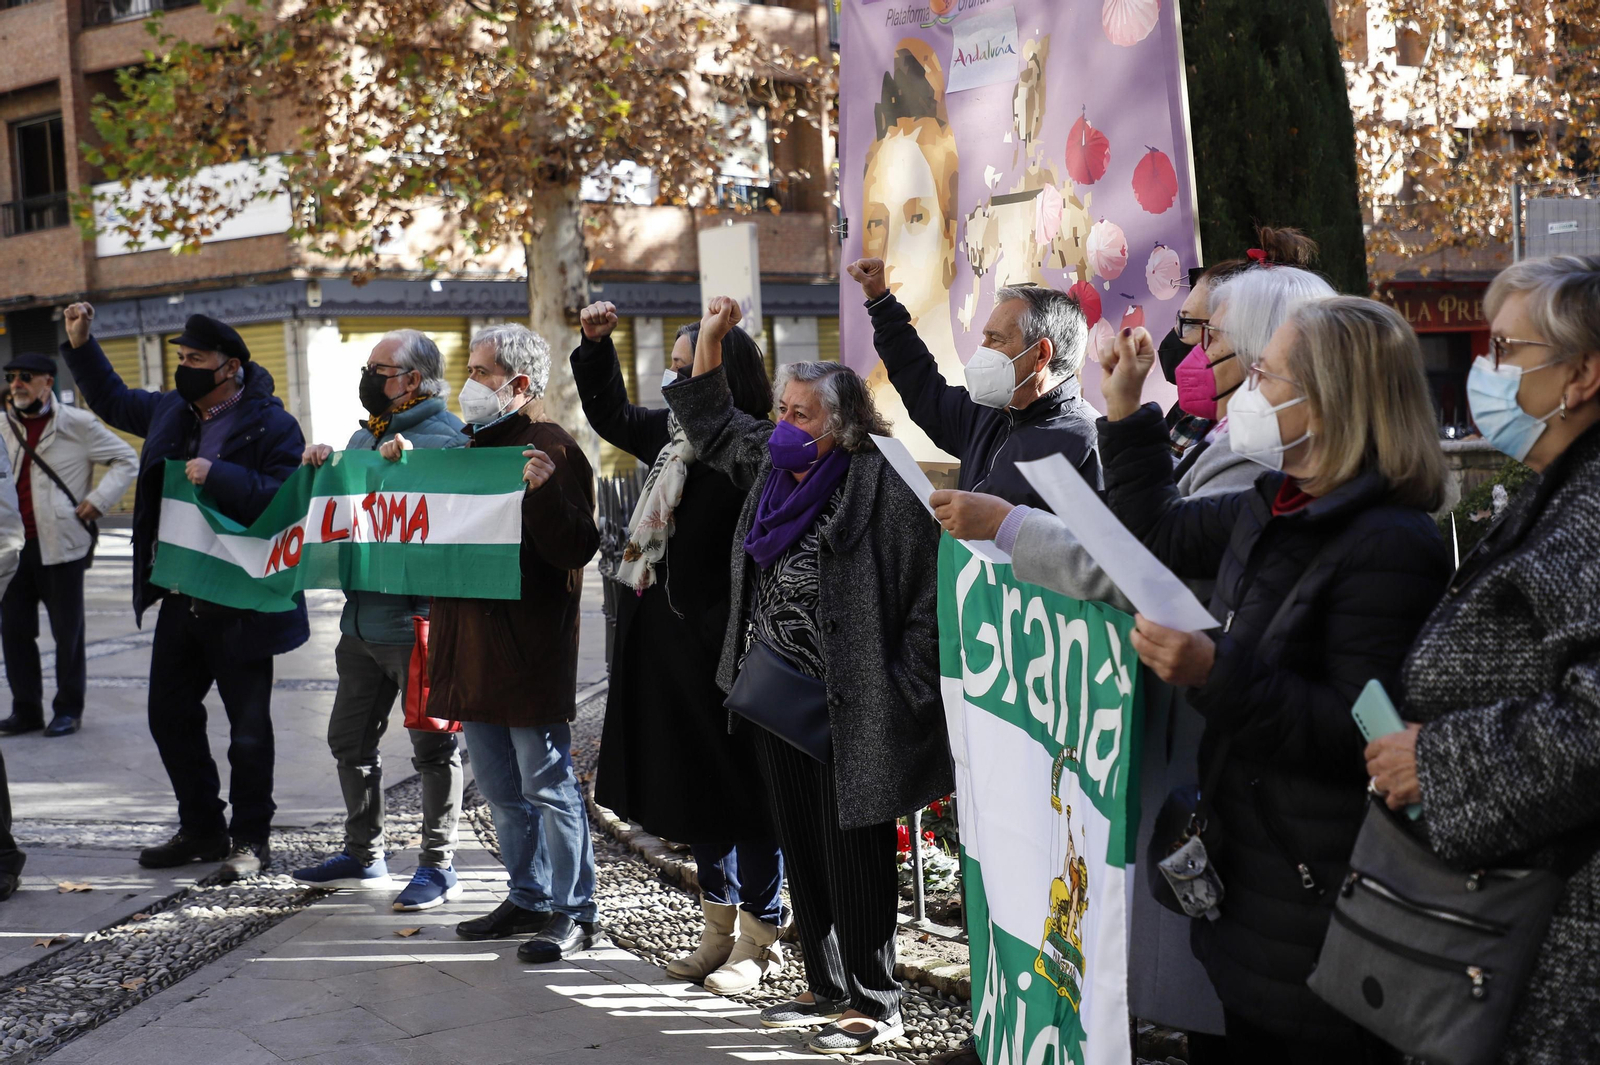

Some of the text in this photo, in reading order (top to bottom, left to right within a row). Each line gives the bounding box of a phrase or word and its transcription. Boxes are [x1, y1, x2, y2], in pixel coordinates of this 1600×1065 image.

[886, 5, 930, 27] Plataforma
[953, 35, 1017, 67] Andalucía
[448, 288, 520, 310] ESQUI
[1437, 294, 1485, 324] PRE
[264, 490, 430, 578] NO LA TOMA
